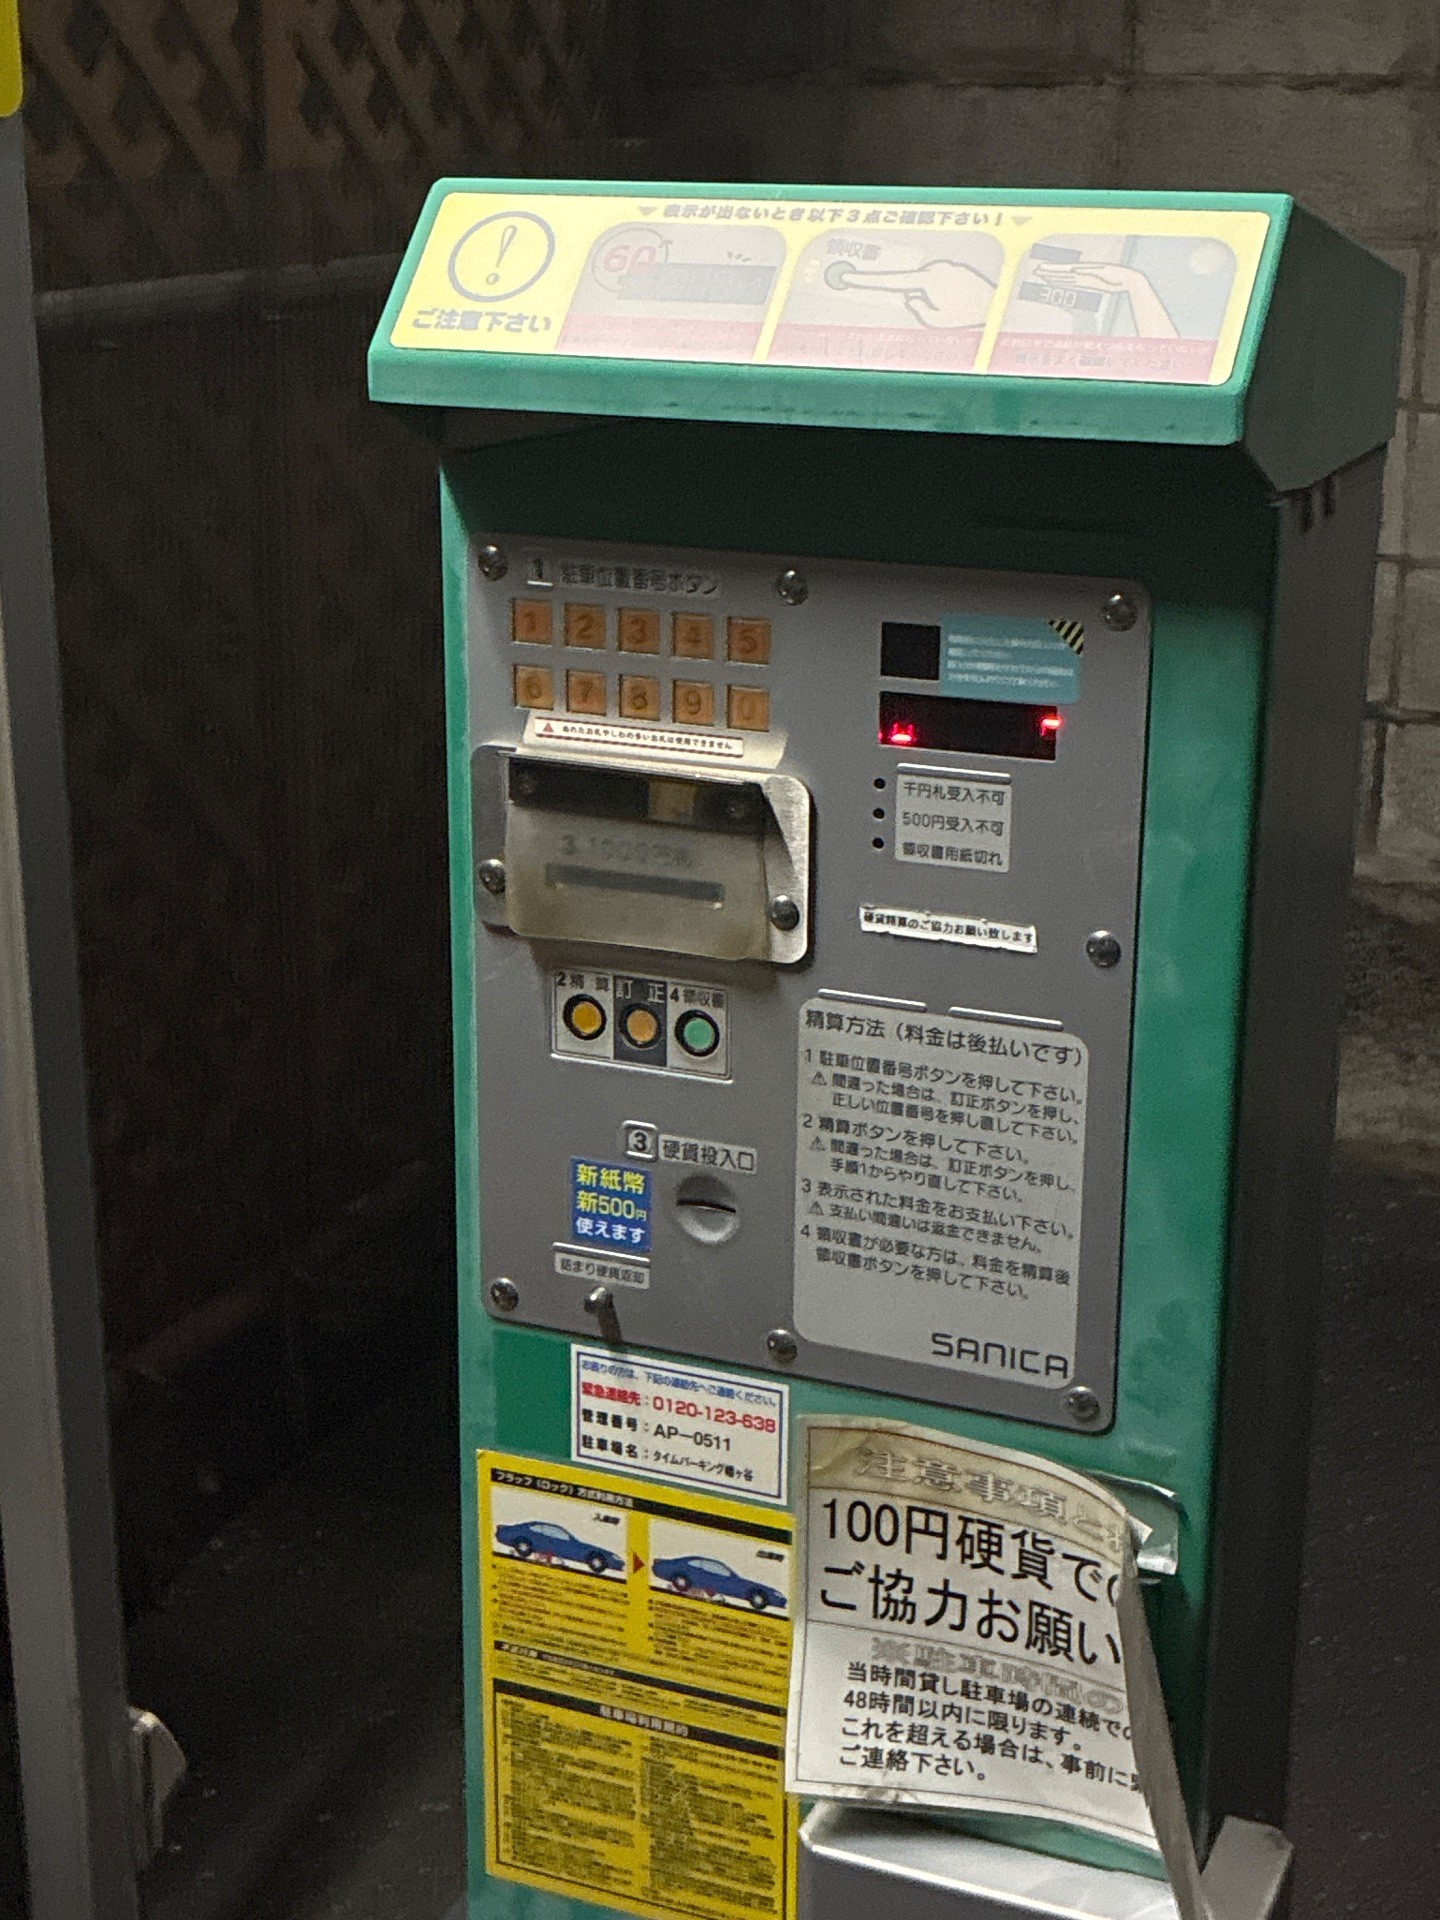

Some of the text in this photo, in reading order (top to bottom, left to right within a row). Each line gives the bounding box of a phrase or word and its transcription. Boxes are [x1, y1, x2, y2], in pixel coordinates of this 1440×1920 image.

[411, 309, 552, 334] ご注意下さい
[903, 781, 1006, 806] 千円札受入不可
[902, 812, 1005, 837] 500円受入不可
[902, 841, 1004, 867] 領収書用紙切れ
[633, 1132, 754, 1172] 3 硬貨投入口
[576, 1163, 646, 1195] 新紙幣
[576, 1189, 647, 1222] 新500円
[576, 1216, 646, 1244] 使えます
[931, 1332, 1069, 1379] SANICA
[820, 1560, 1122, 1665] ご協力お願い
[844, 1690, 1081, 1751] 48時間以内に限ります。
[840, 1744, 985, 1781] ご連絡下さい。
